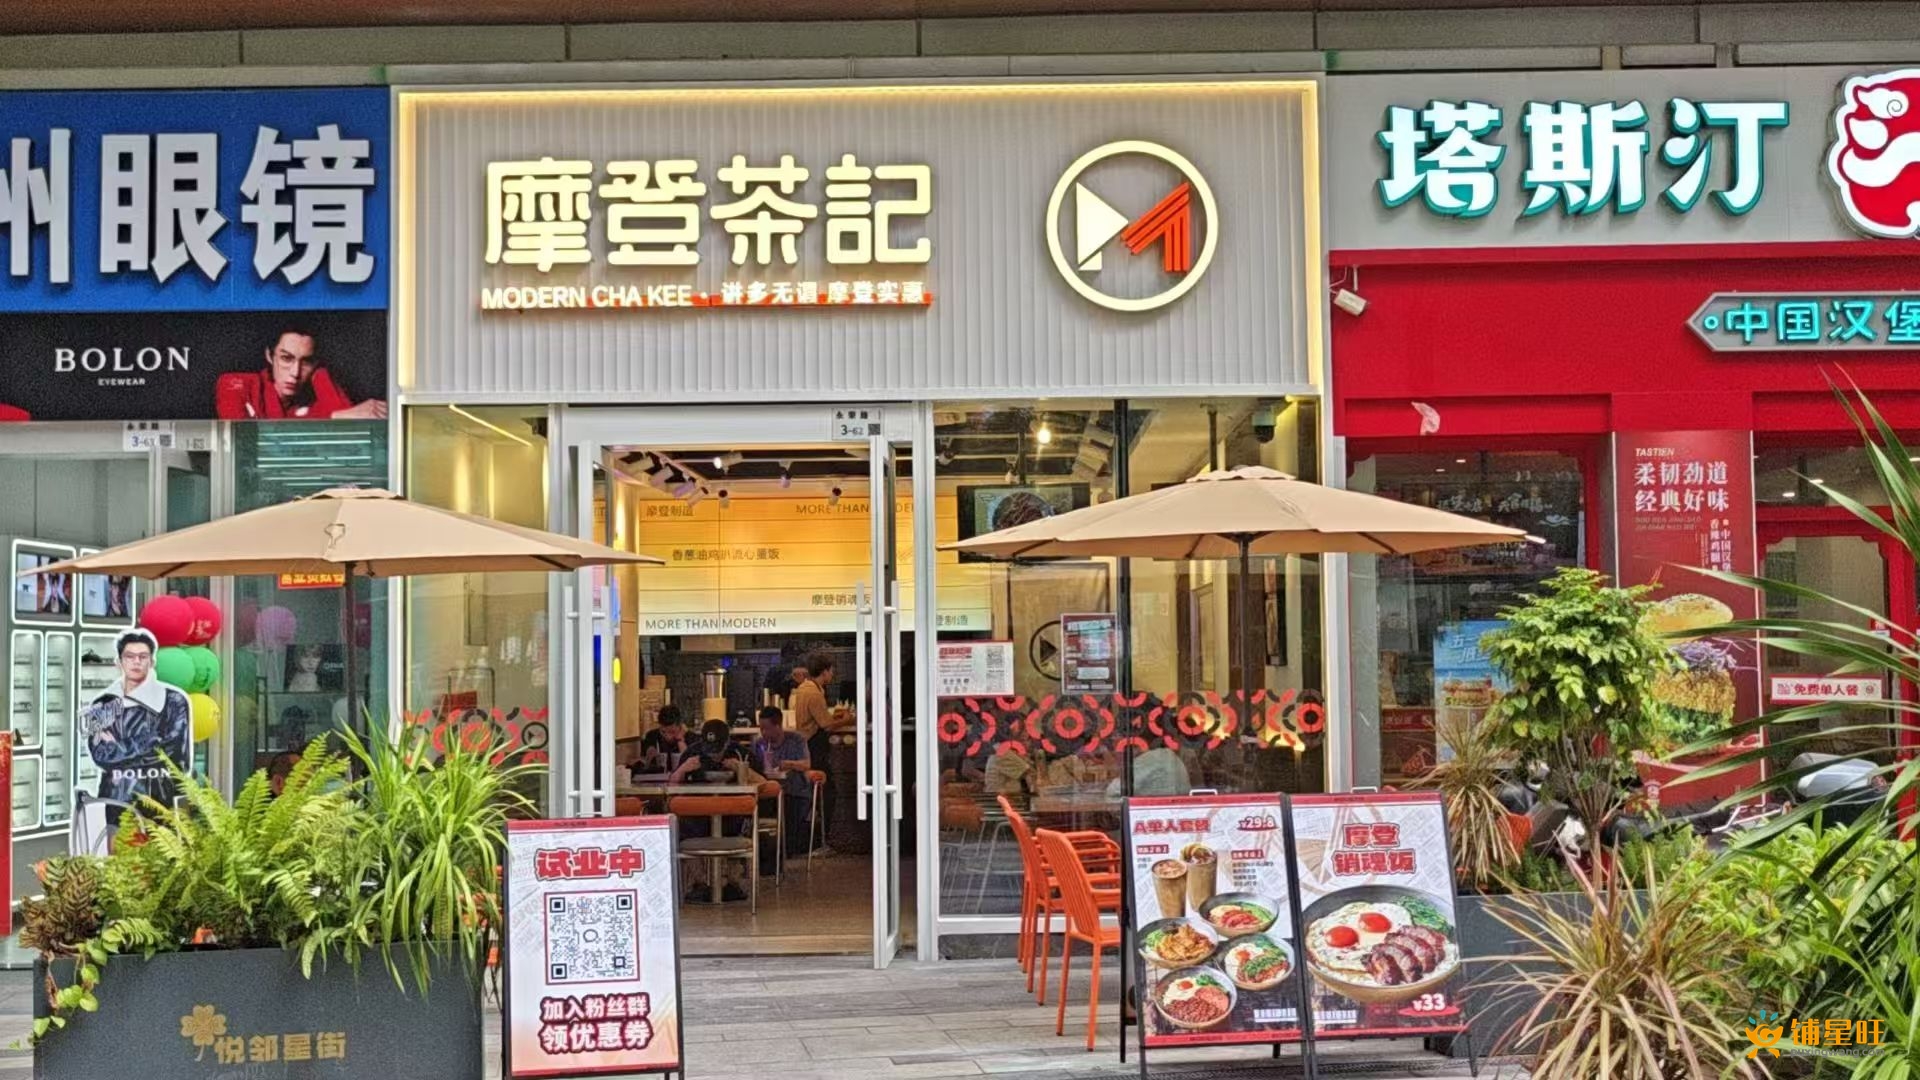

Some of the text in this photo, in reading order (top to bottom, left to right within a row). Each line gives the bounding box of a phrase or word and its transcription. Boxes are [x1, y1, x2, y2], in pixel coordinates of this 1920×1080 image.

[1377, 97, 1790, 217] 塔斯汀
[484, 154, 932, 272] 摩登茶記
[481, 285, 692, 309] MODERN CHA KEE
[828, 281, 924, 304] 摩登实惠
[1724, 301, 1920, 344] 中国汉堡
[54, 347, 190, 372] BOLON
[98, 378, 146, 386] EYEWEAR
[1635, 448, 1674, 456] TASTIEN
[1634, 461, 1728, 485] 柔韧劲道
[796, 503, 869, 514] MORE THAN
[1635, 488, 1729, 512] 经典好味
[645, 617, 777, 630] MORE THAN MODERN
[1794, 684, 1858, 696] 免费单人餐
[112, 768, 170, 780] BOLON
[536, 846, 644, 879] 试业中
[542, 996, 650, 1021] 加入粉丝群
[1412, 993, 1446, 1011] ¥33
[214, 1031, 346, 1065] 悦邻星街
[540, 1022, 651, 1051] 领优惠券
